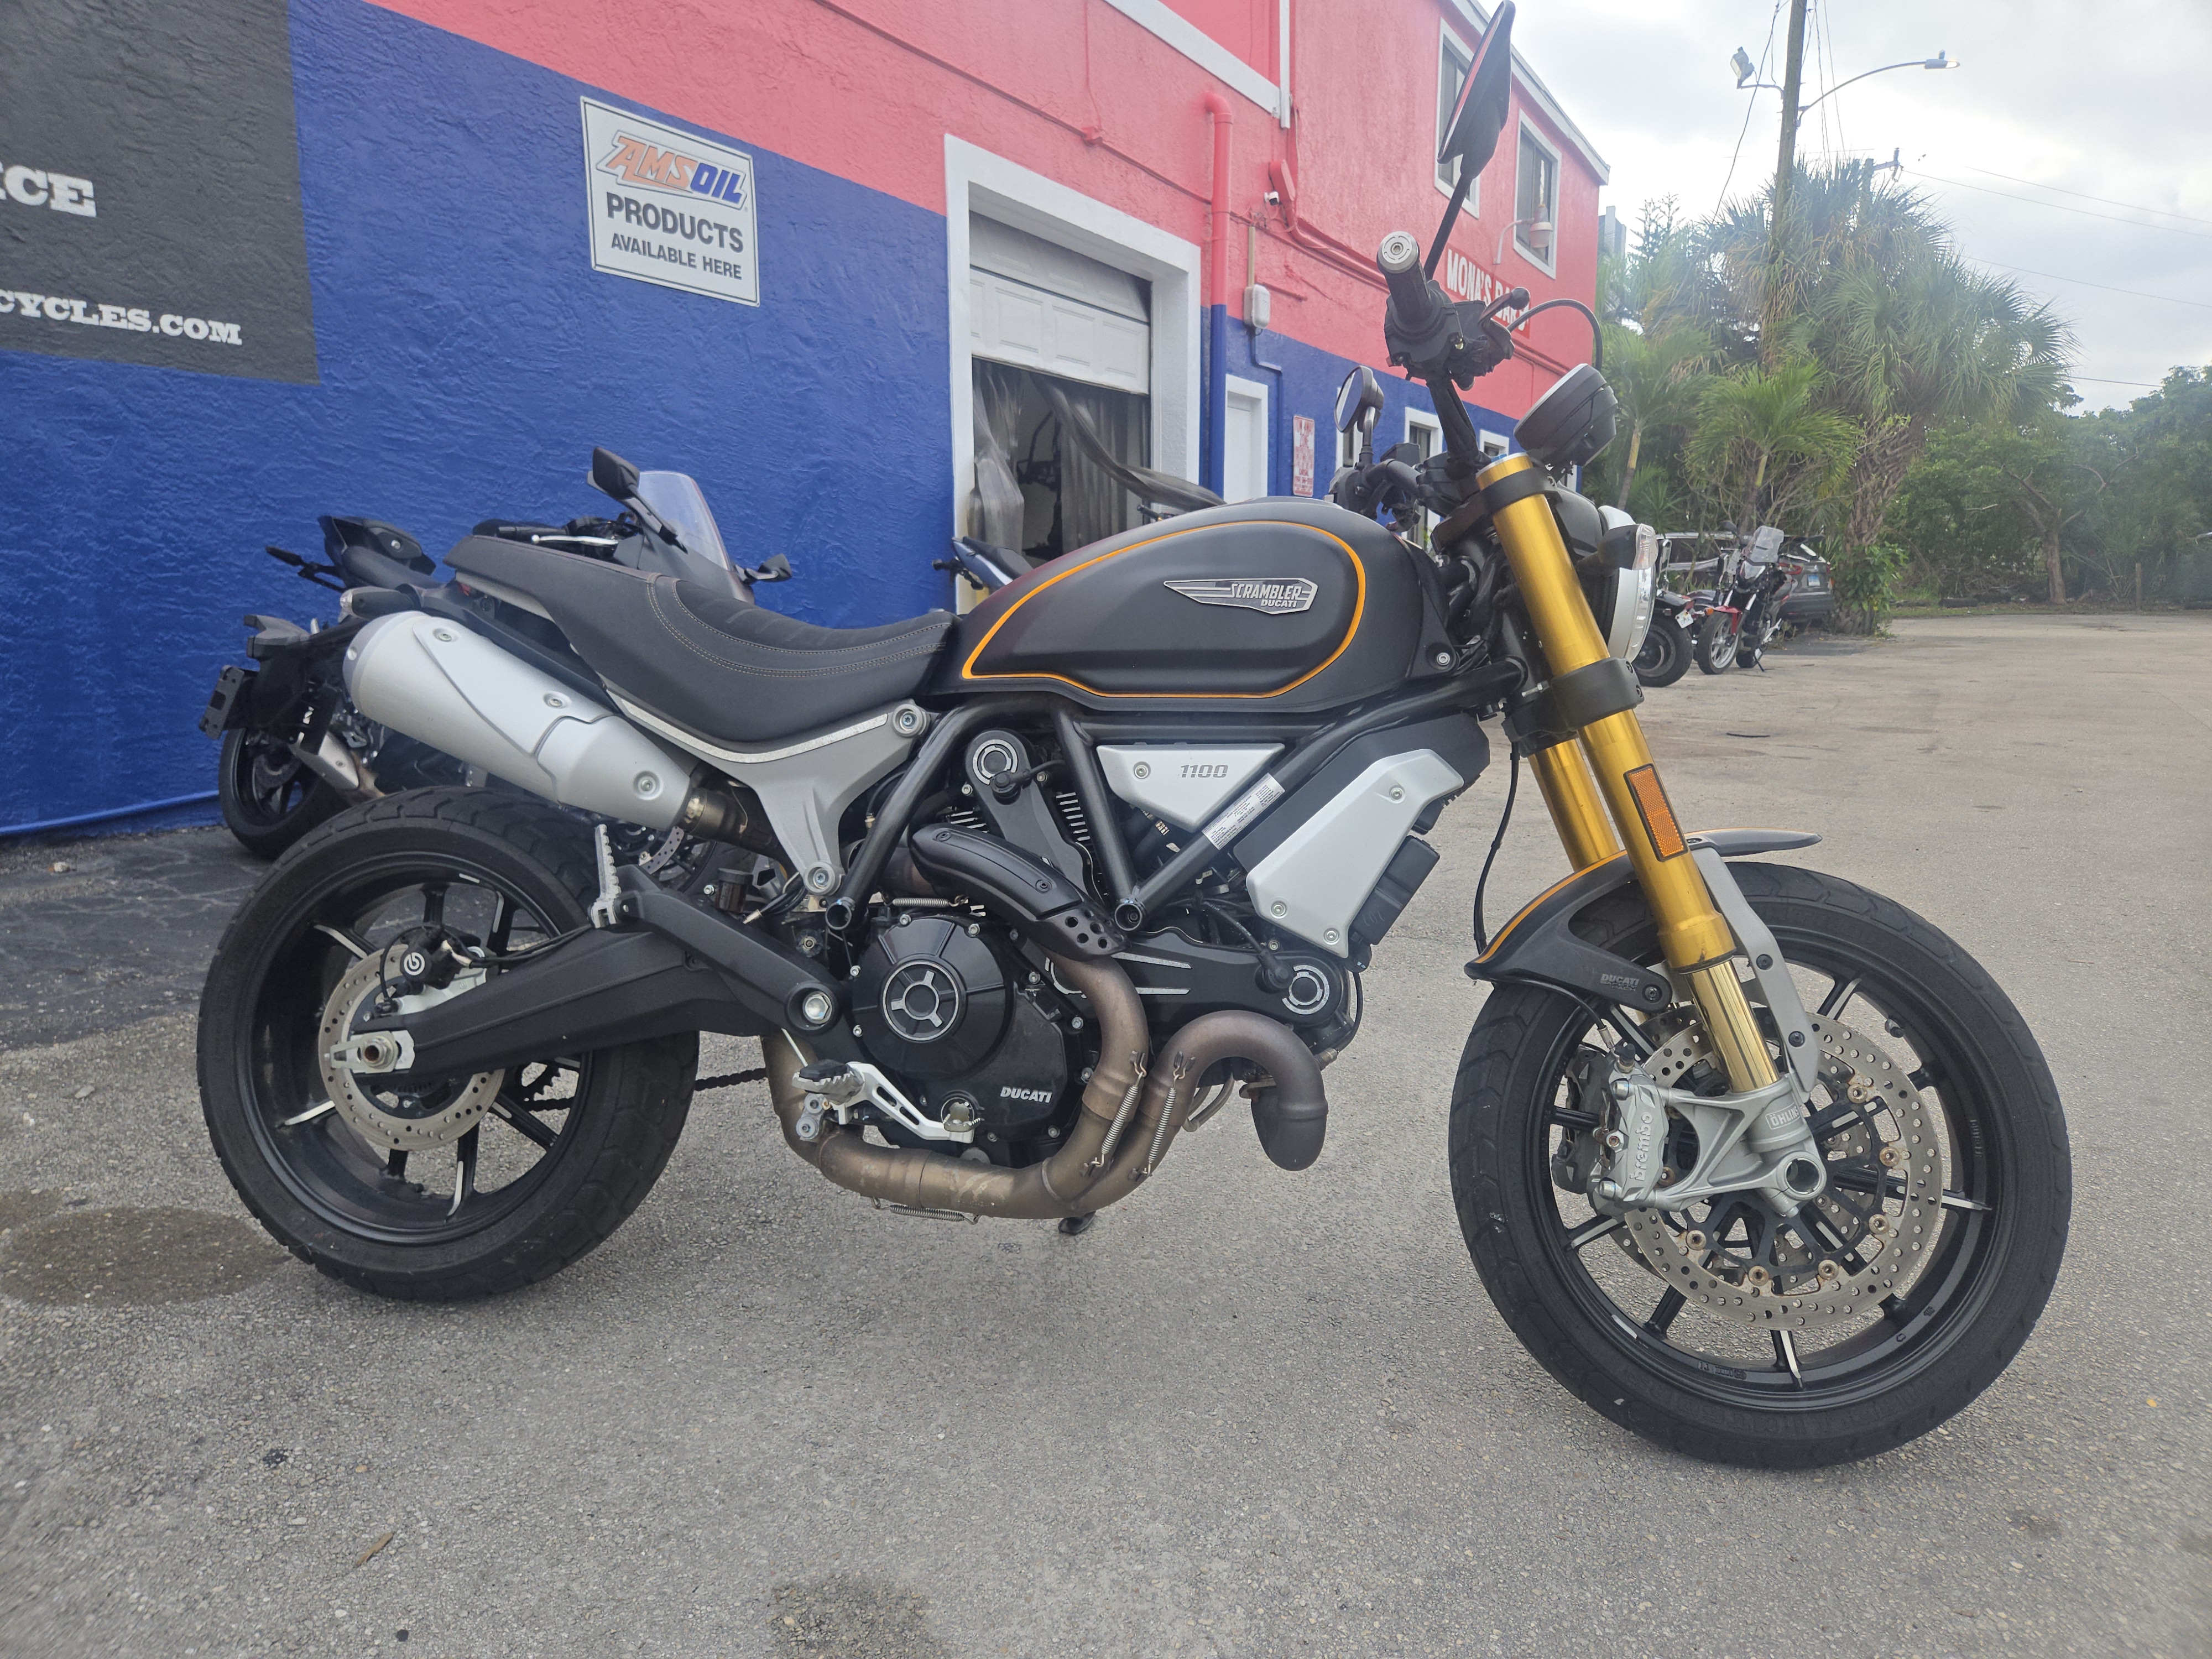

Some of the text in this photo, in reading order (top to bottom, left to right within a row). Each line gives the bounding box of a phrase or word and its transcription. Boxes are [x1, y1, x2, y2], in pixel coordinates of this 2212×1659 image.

[0, 162, 97, 217] CE
[605, 135, 743, 204] AMSOIL
[606, 191, 744, 253] PRODUCTS
[611, 233, 742, 280] AVAILABLE HERE
[1447, 249, 1491, 307] MONA'S
[1231, 583, 1302, 600] SCRAMBLER
[1260, 599, 1297, 608] DUCATI
[1181, 764, 1229, 778] 1100
[1601, 973, 1640, 985] DUCATI
[1000, 1087, 1052, 1103] DUCATI
[1629, 1112, 1653, 1181] brembo
